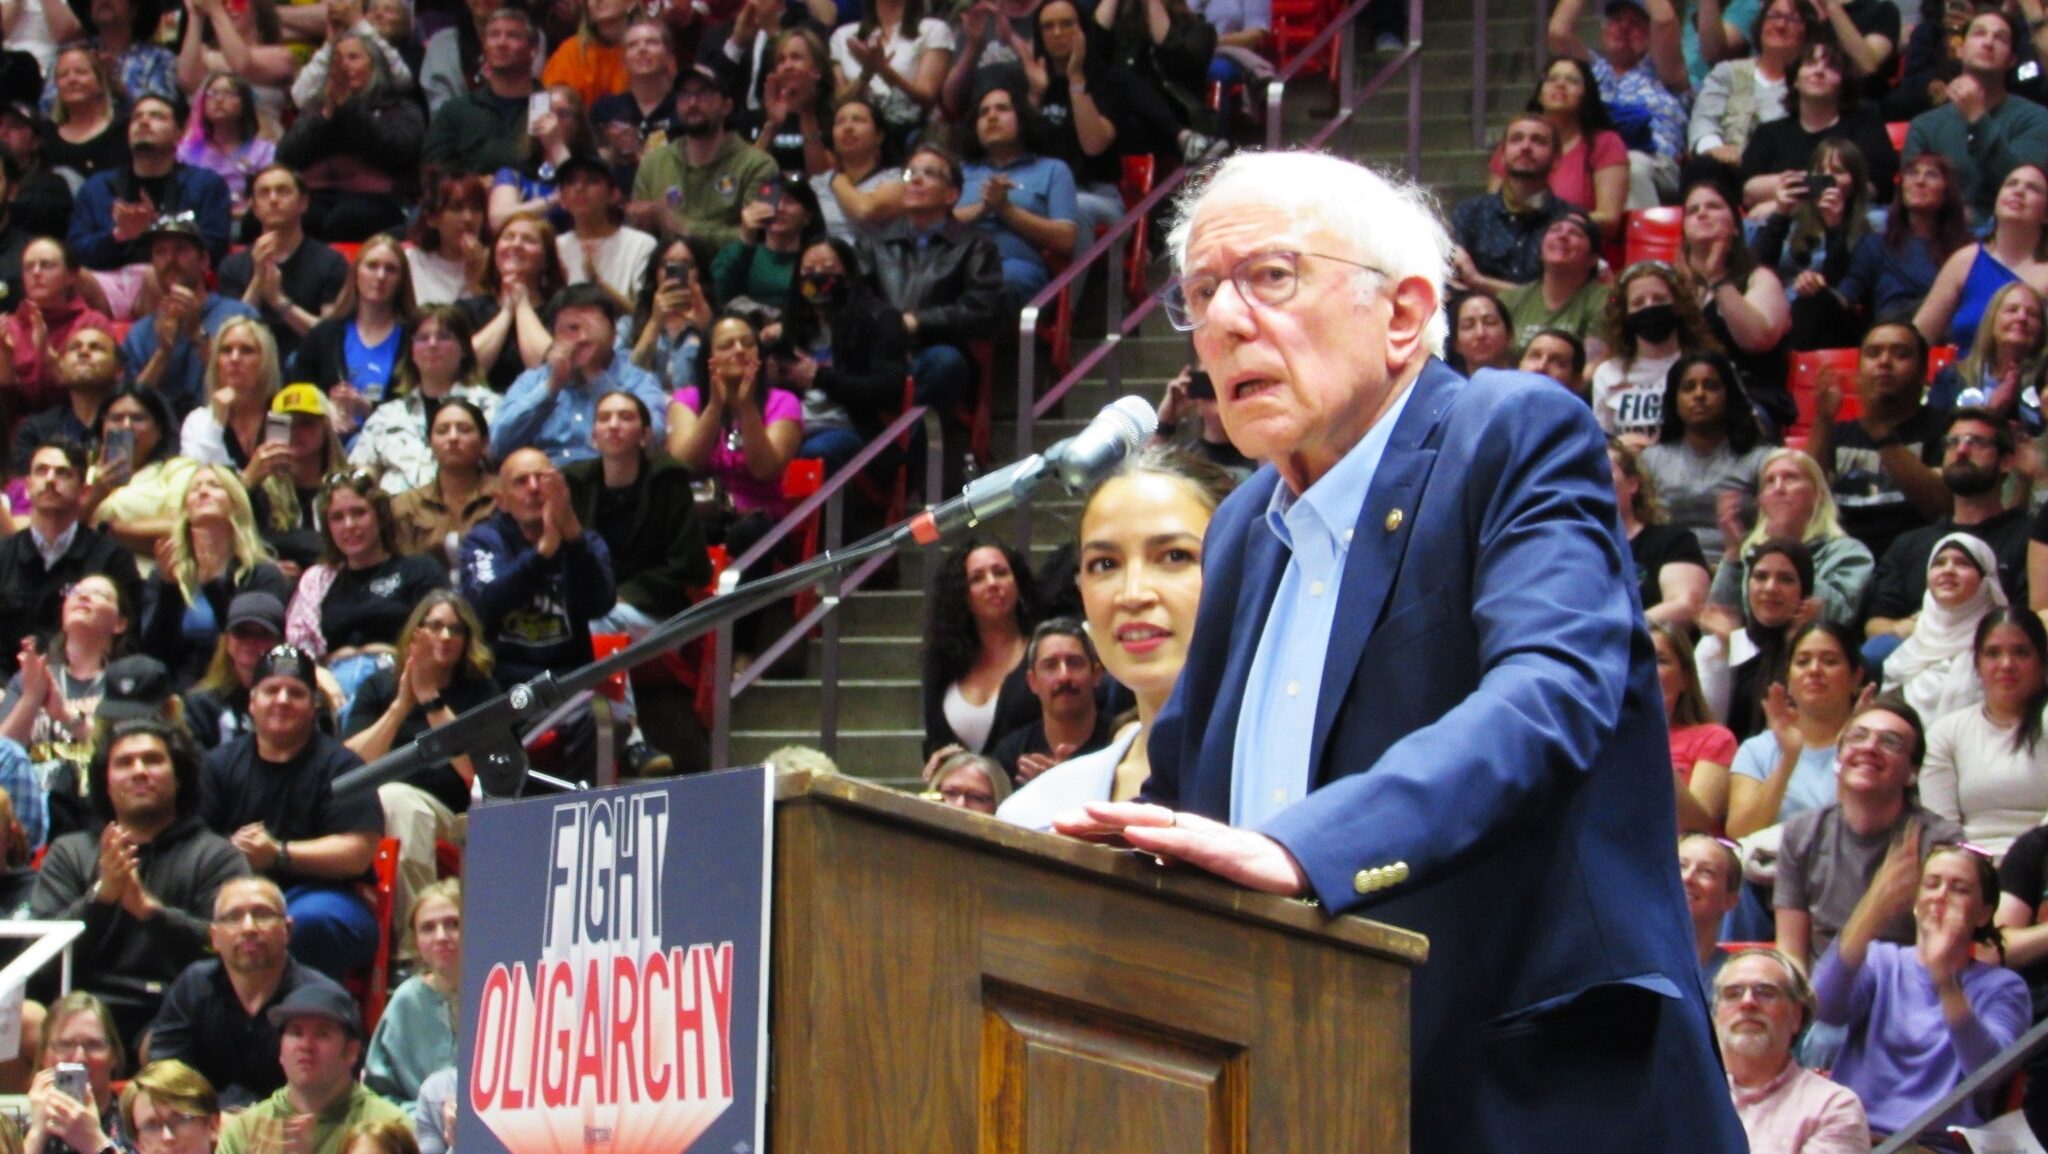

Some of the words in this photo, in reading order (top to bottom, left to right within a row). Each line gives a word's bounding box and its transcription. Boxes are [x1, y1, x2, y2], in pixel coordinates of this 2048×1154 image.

[1619, 393, 1661, 421] FIG
[543, 790, 669, 950] FIGHT
[470, 942, 734, 1113] OLIGARCHY
